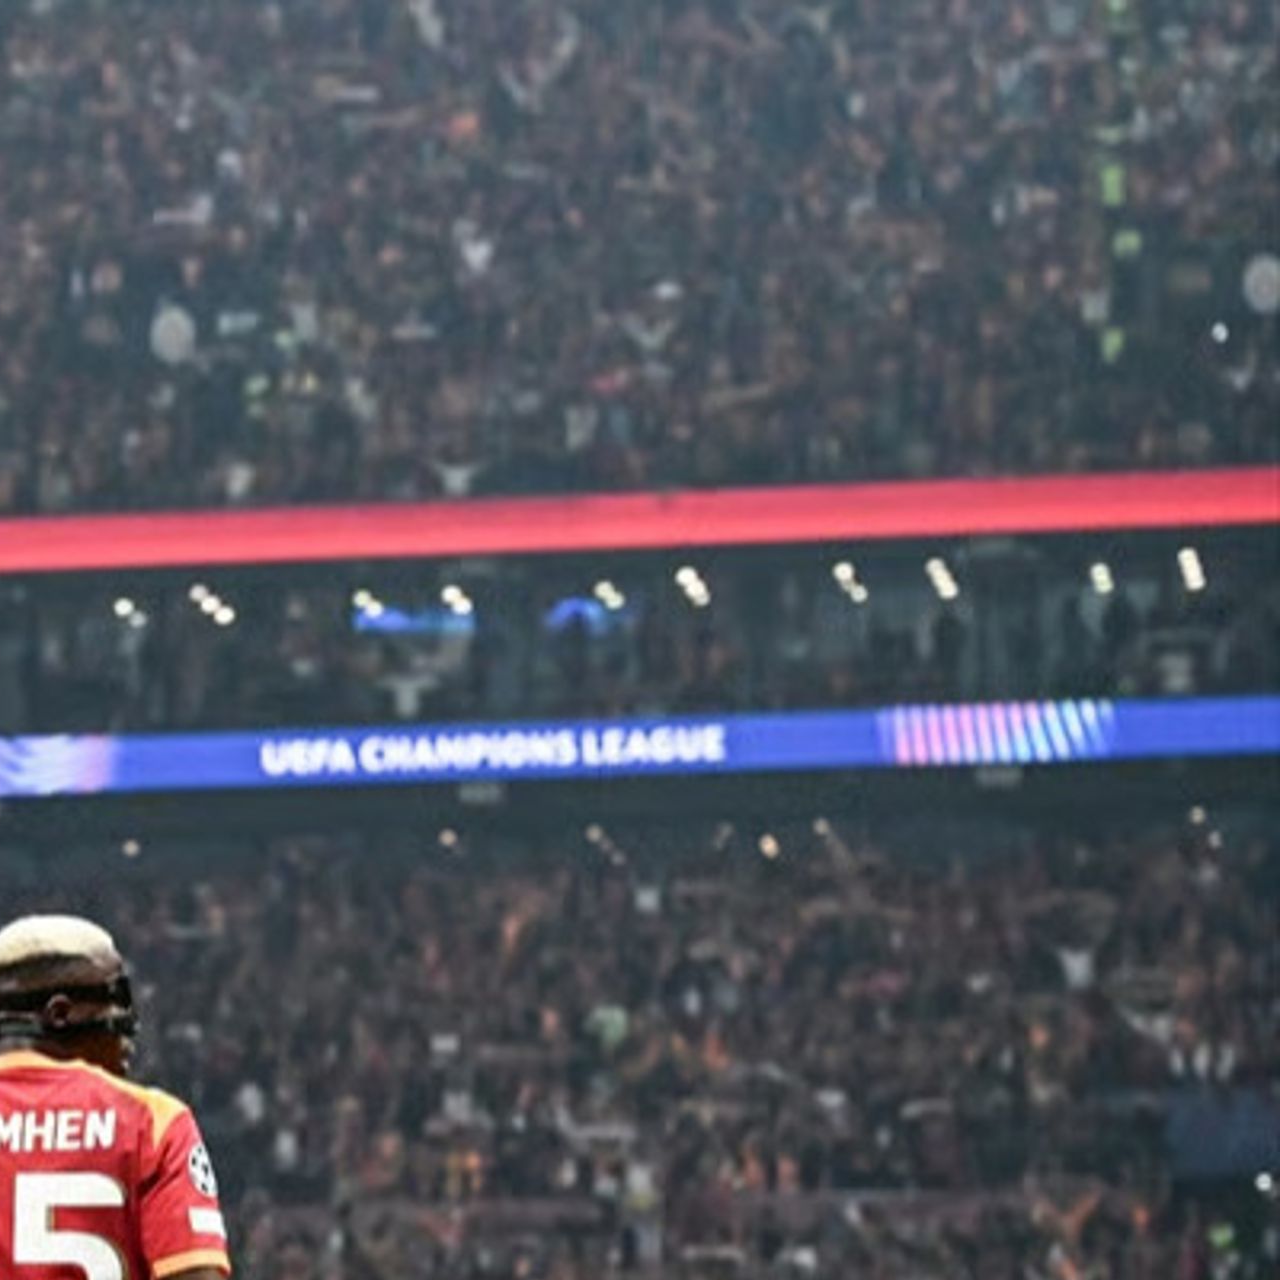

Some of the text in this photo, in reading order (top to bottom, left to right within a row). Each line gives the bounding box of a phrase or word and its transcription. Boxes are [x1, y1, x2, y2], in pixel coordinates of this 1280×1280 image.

[260, 724, 726, 776] UEFA CHAMPIONS LEAGUE
